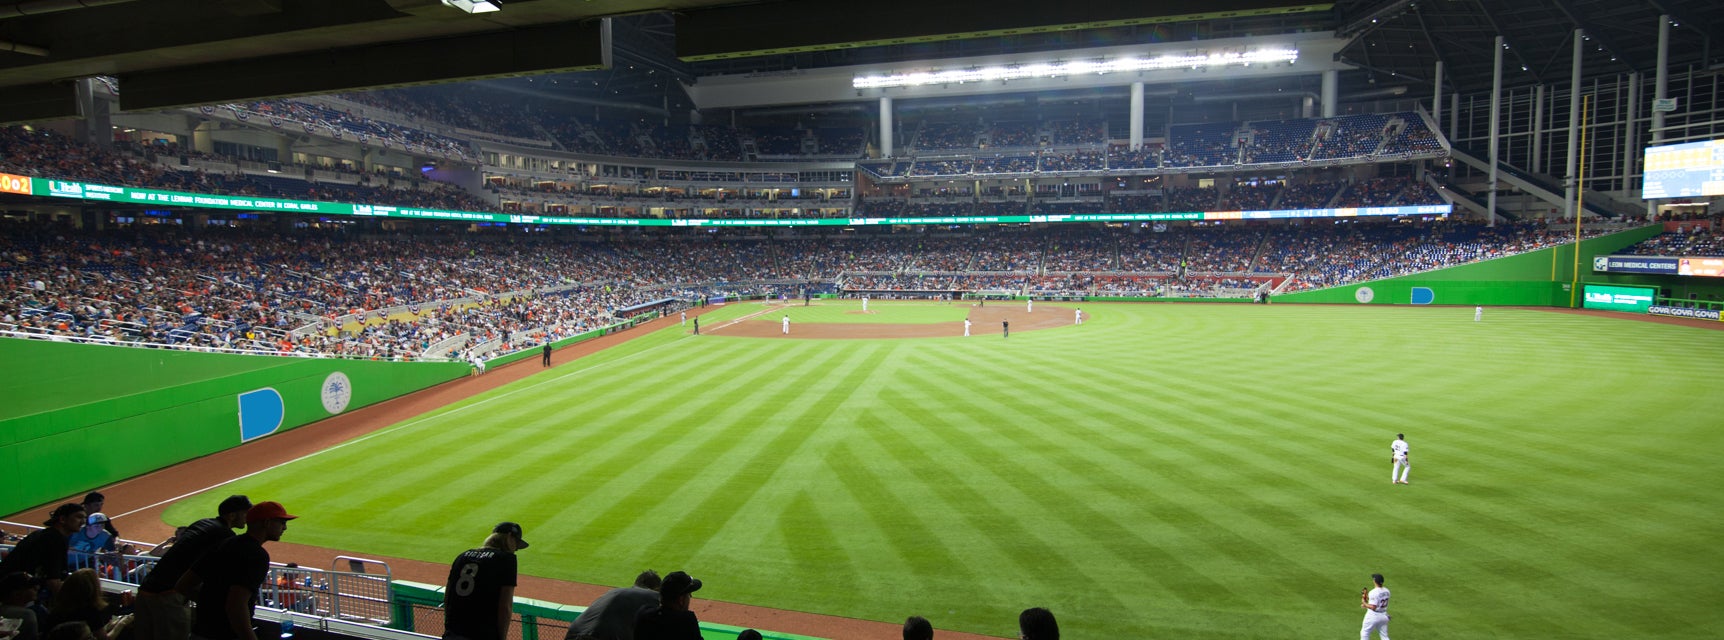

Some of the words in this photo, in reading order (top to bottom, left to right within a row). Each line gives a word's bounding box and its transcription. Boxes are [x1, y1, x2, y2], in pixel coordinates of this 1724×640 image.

[148, 193, 156, 201] AT
[157, 193, 169, 202] THE
[1648, 262, 1677, 270] CENTERS
[1648, 306, 1671, 315] GOYA
[1670, 308, 1694, 317] GOYA
[1694, 310, 1719, 319] GOYA
[456, 563, 479, 597] 8
